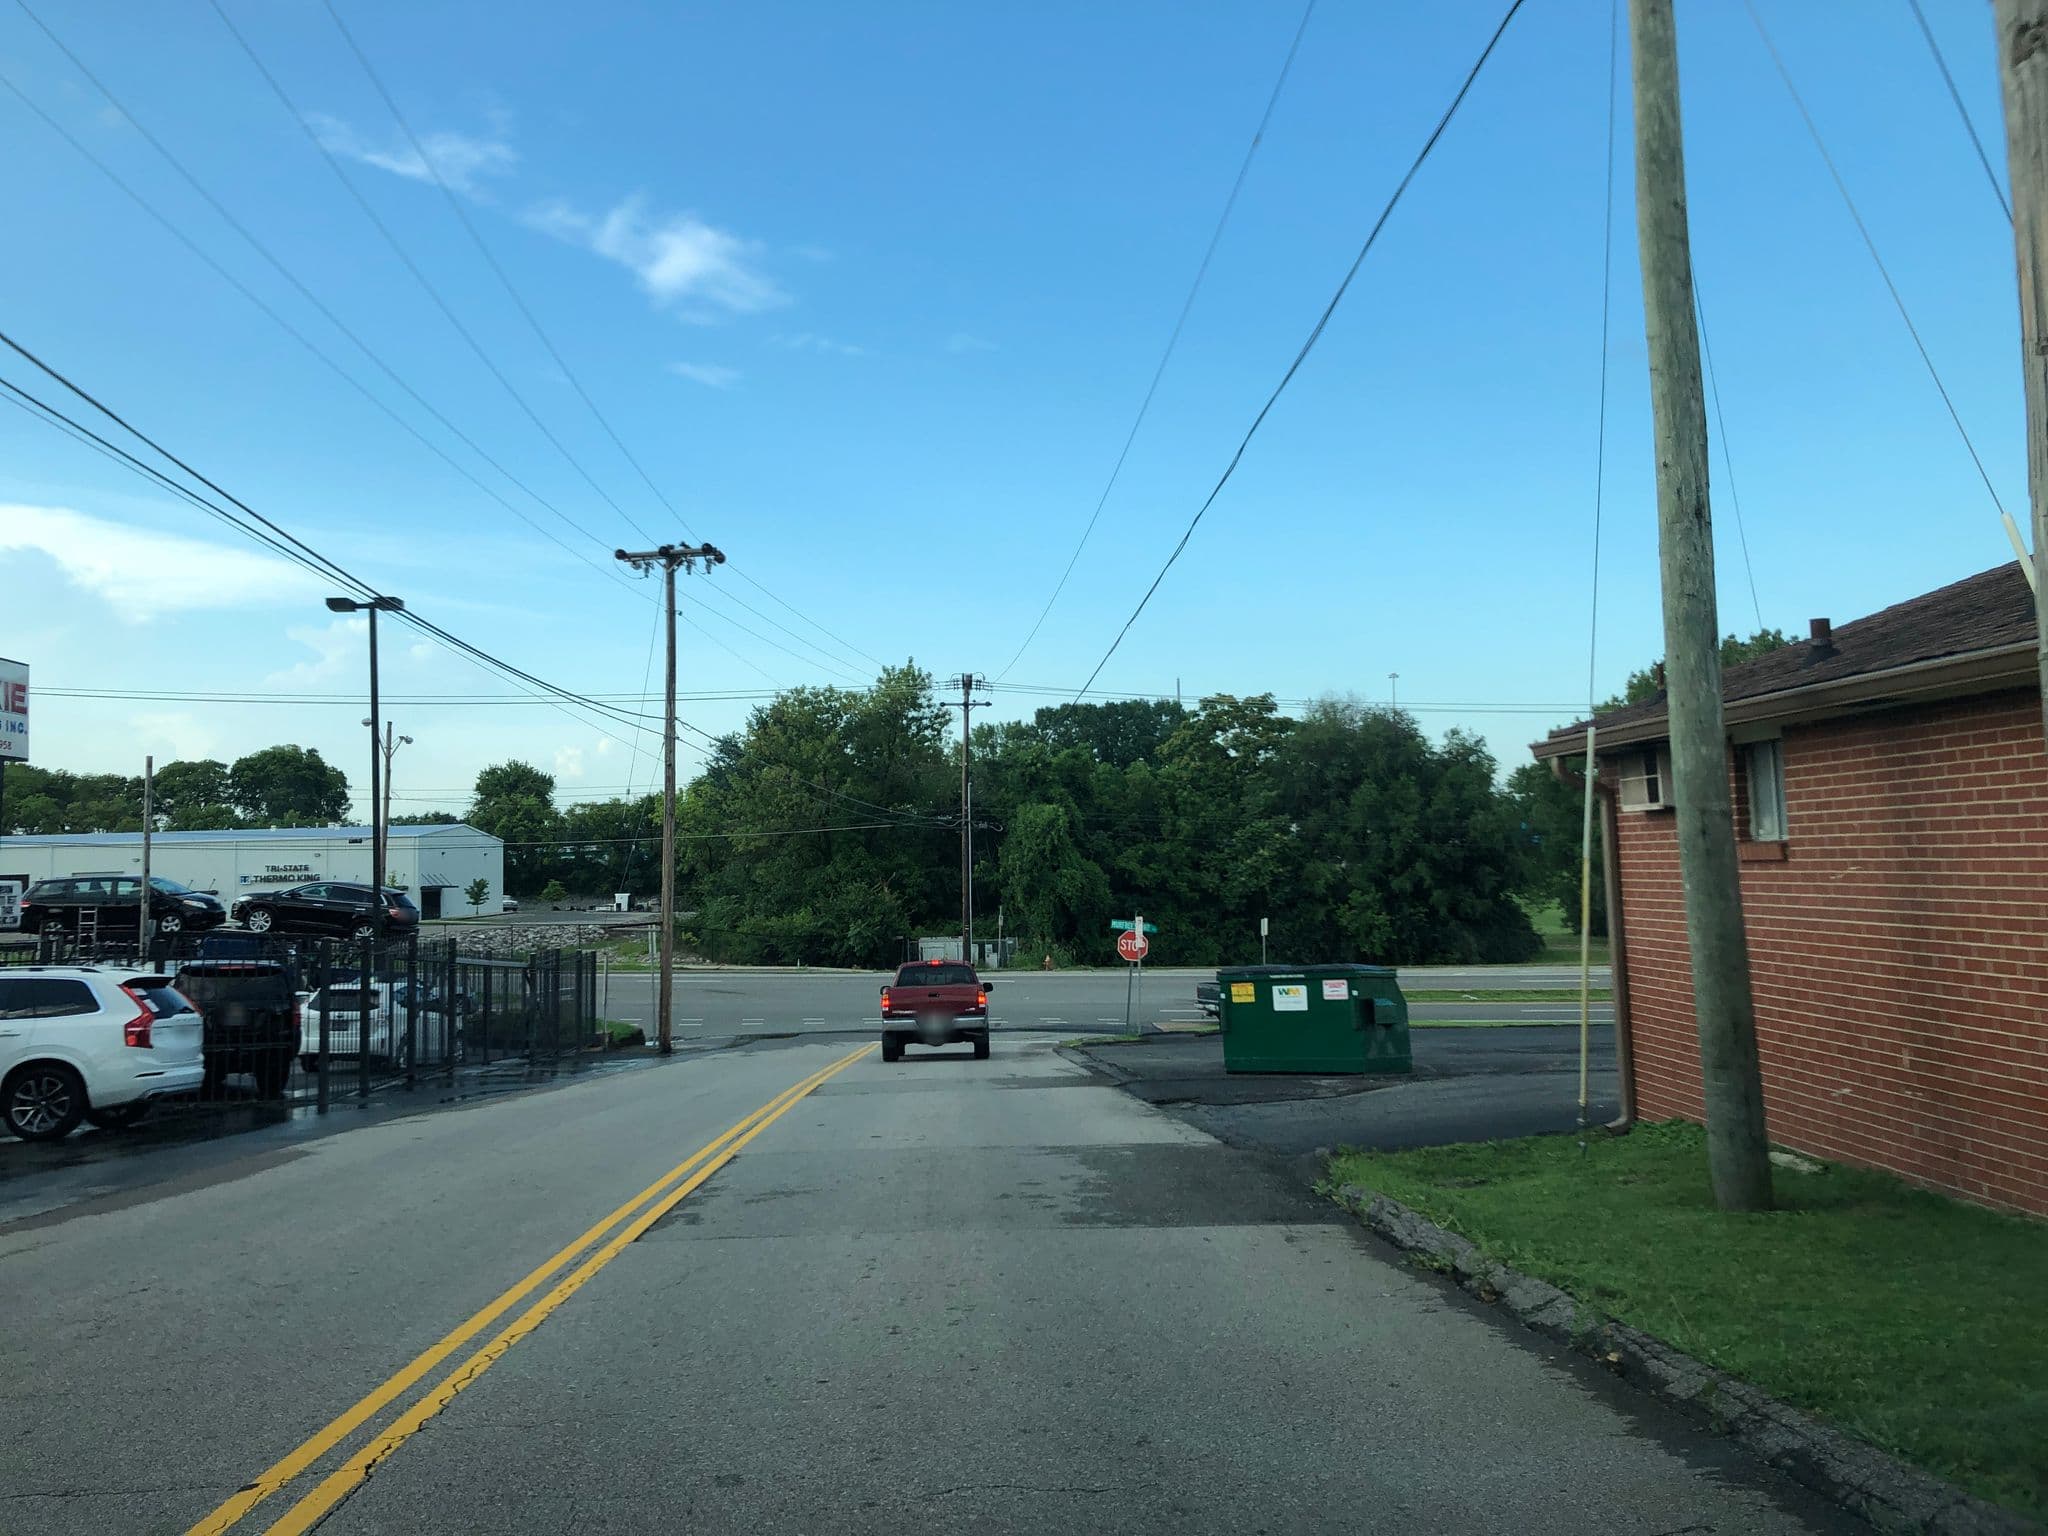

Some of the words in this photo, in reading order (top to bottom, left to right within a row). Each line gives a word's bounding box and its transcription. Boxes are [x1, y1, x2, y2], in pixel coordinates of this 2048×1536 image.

[0, 681, 27, 714] IE
[254, 874, 295, 883] THERMO
[297, 873, 320, 882] KING
